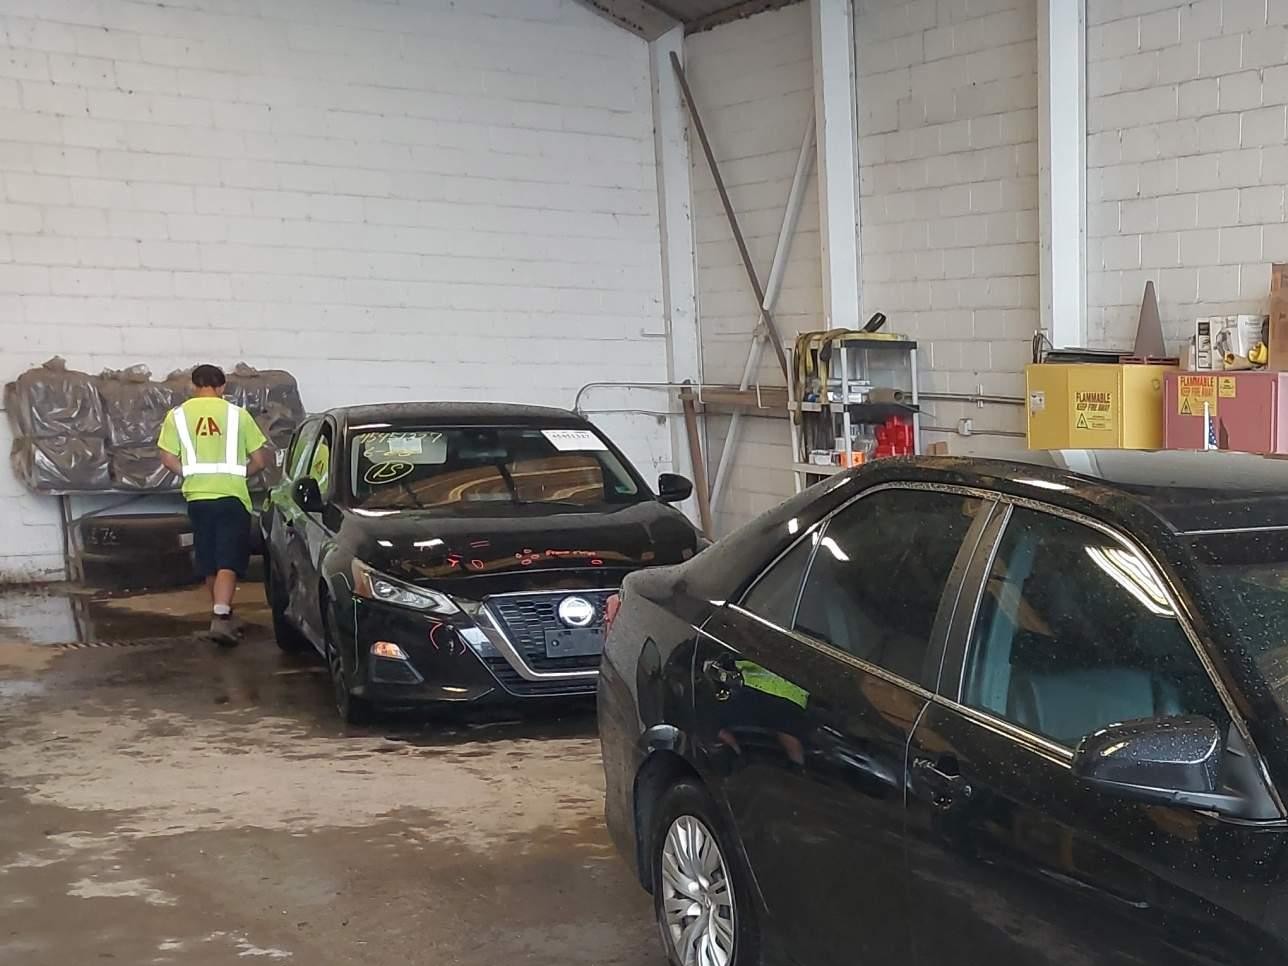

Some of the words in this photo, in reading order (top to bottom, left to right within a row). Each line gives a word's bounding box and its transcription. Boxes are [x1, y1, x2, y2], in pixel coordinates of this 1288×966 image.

[1181, 376, 1214, 387] FLAMMABLE
[1076, 392, 1111, 403] FLAMMABLE
[1076, 403, 1088, 411] KEEP
[1098, 404, 1111, 412] AWAY
